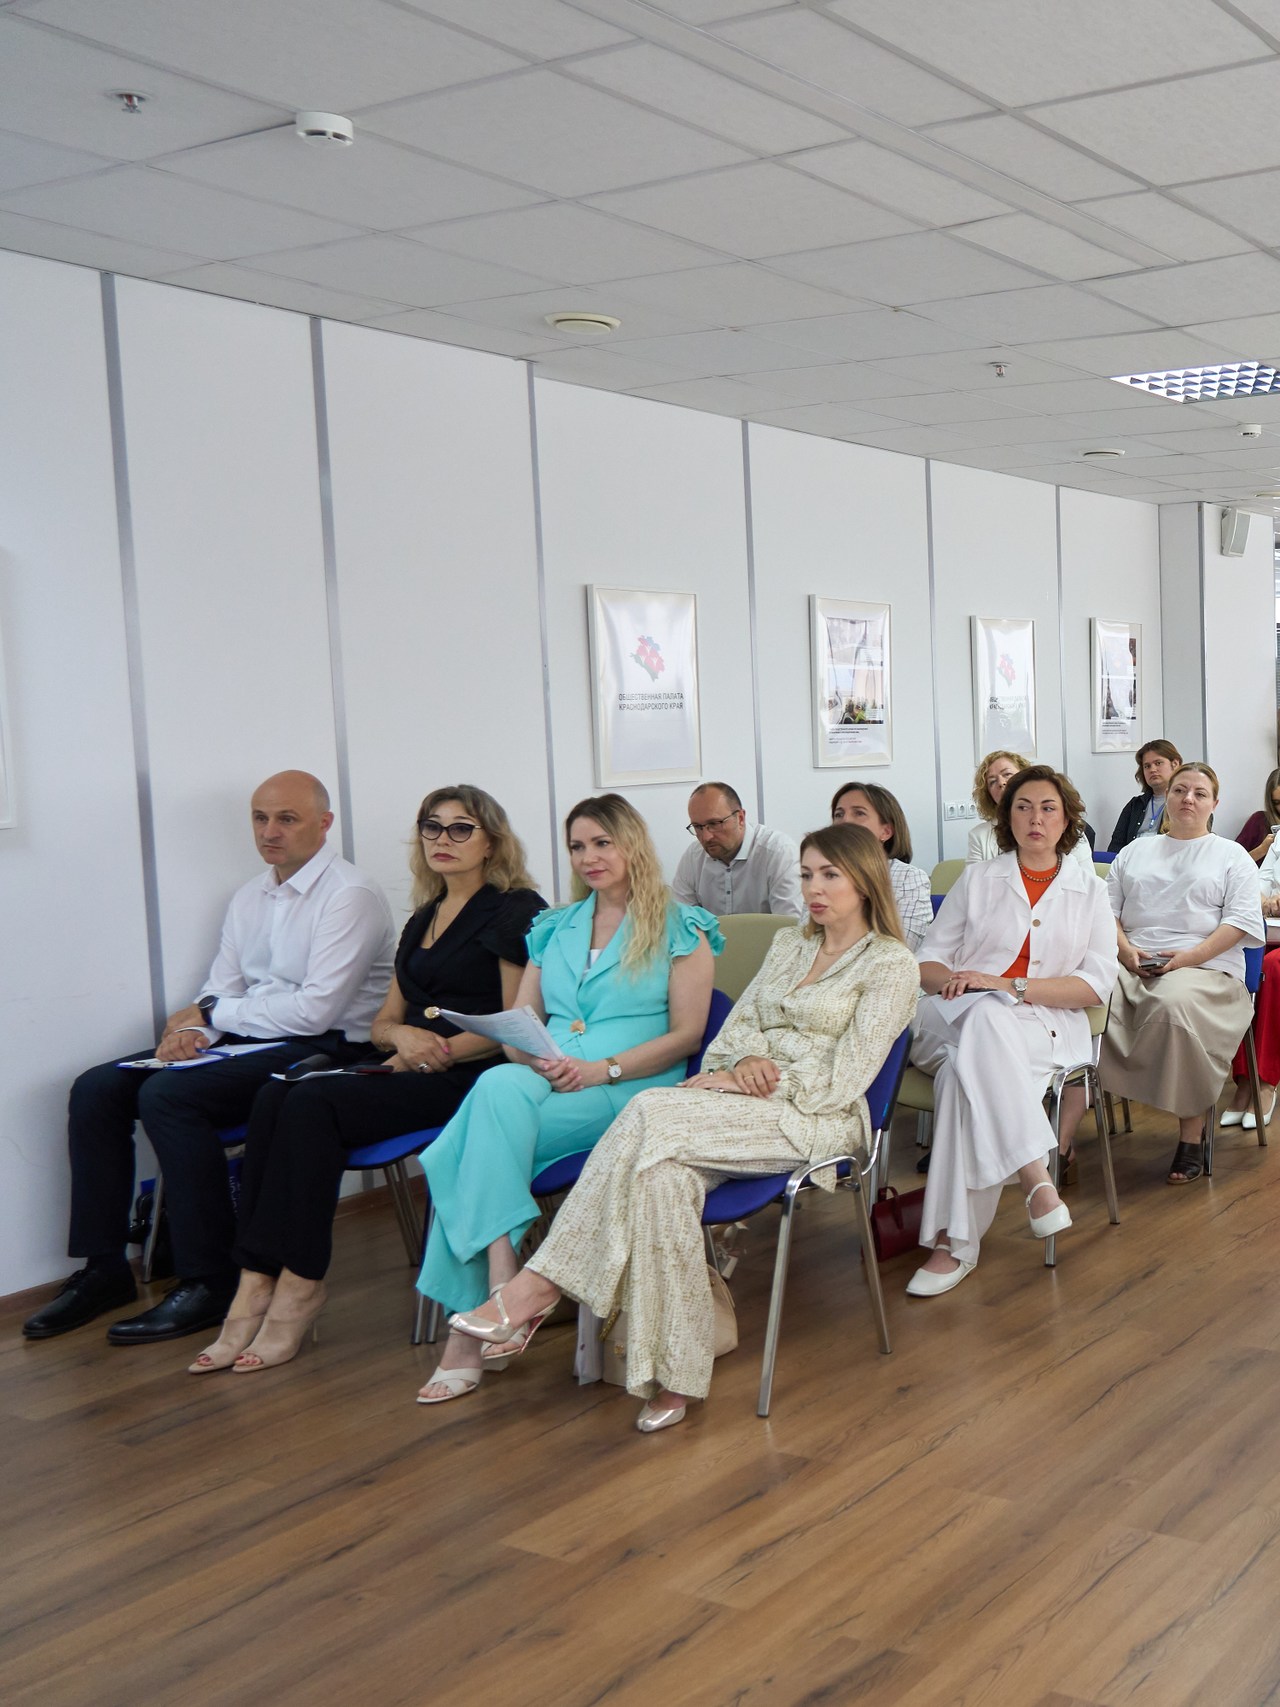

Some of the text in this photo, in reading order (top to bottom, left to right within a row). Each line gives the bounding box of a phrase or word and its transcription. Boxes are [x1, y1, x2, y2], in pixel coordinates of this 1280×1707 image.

[618, 692, 684, 701] ОБЩЕСТВЕННАЯ ПАЛАТА
[618, 702, 684, 711] КРАСНОДАРСКОГО КРАЯ
